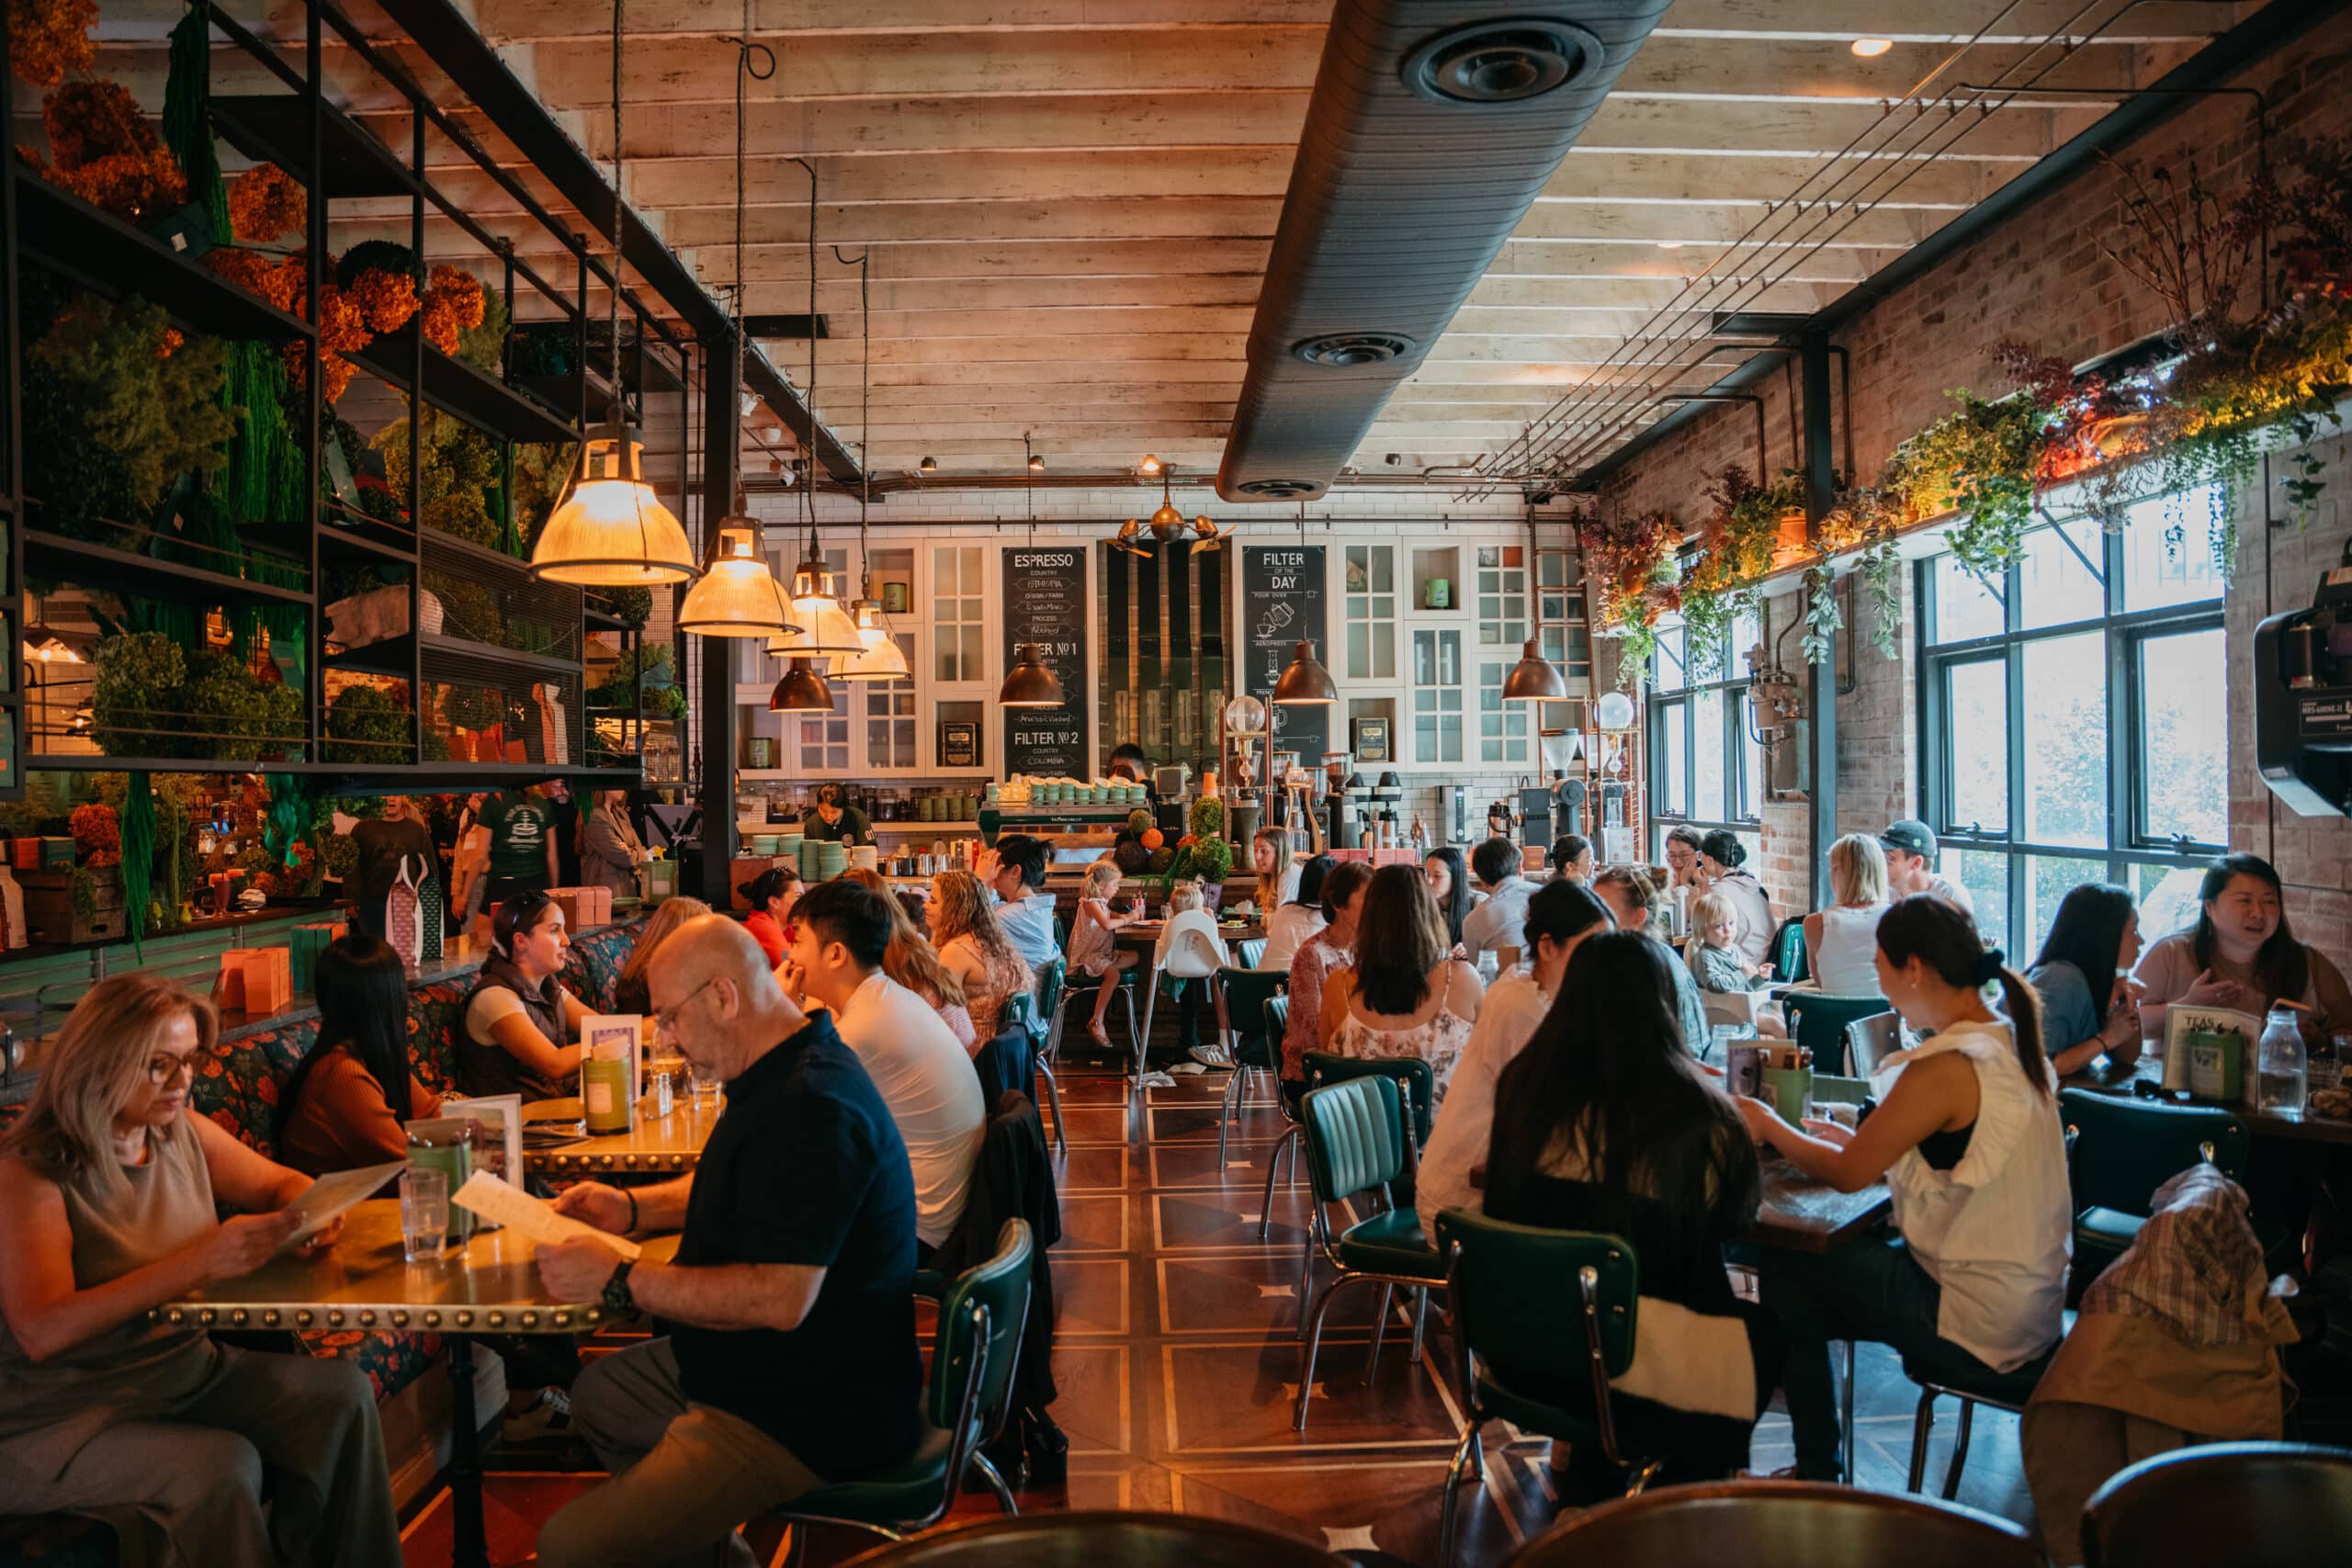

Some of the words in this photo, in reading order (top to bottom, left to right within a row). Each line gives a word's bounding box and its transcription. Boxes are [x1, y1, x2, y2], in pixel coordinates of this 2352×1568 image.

[1014, 554, 1073, 567] ESPRESSO
[1263, 553, 1304, 566] FILTER
[1272, 576, 1296, 589] DAY
[1072, 642, 1077, 655] 1
[1014, 732, 1055, 745] FILTER
[1071, 731, 1079, 744] 2
[2185, 1015, 2214, 1027] TEAS
